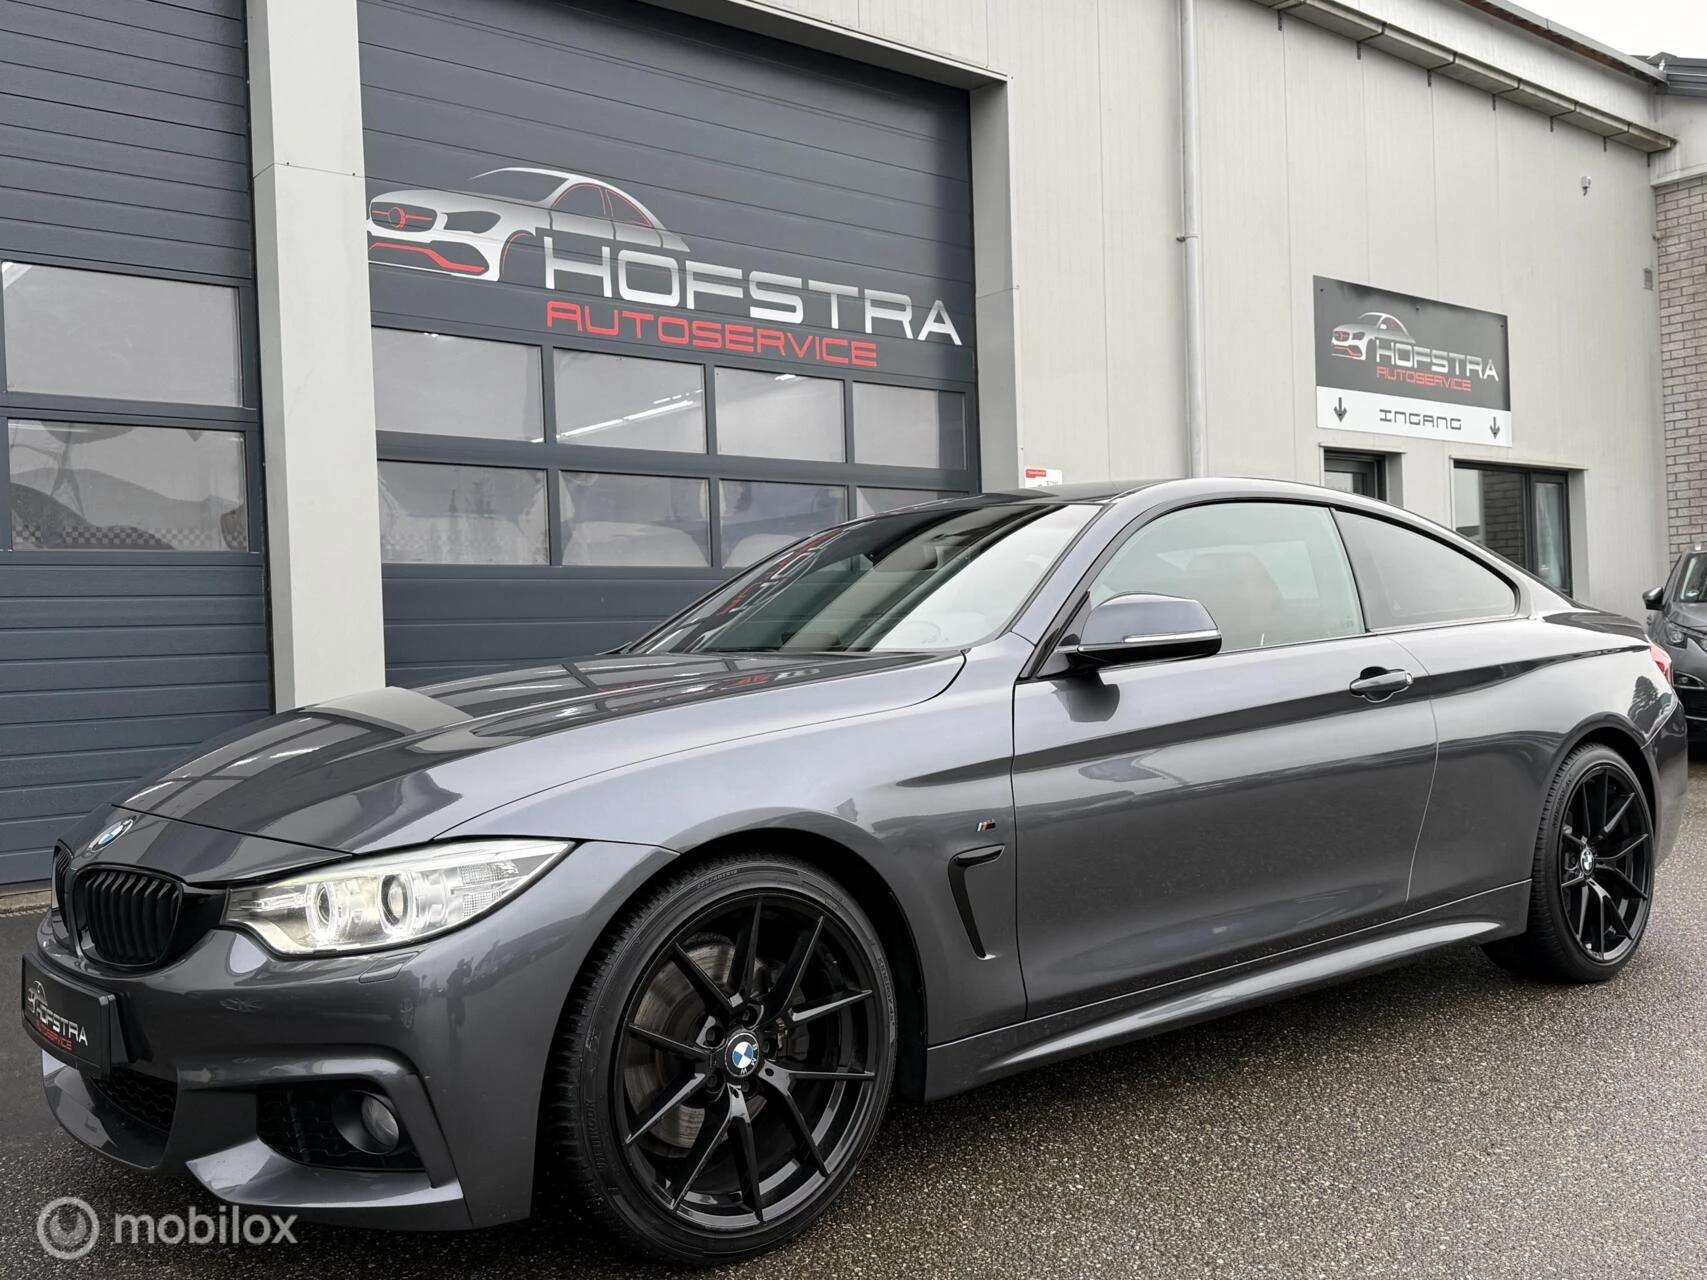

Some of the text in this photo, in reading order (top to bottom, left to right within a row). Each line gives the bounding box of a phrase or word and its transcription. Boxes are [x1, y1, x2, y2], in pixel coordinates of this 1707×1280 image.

[544, 236, 962, 346] HOFSTRA
[546, 300, 877, 367] AUTOSERVICE
[1376, 339, 1499, 381] HOFSTRA
[1376, 366, 1472, 391] AUTOSERVICE
[1379, 408, 1462, 430] INGANG
